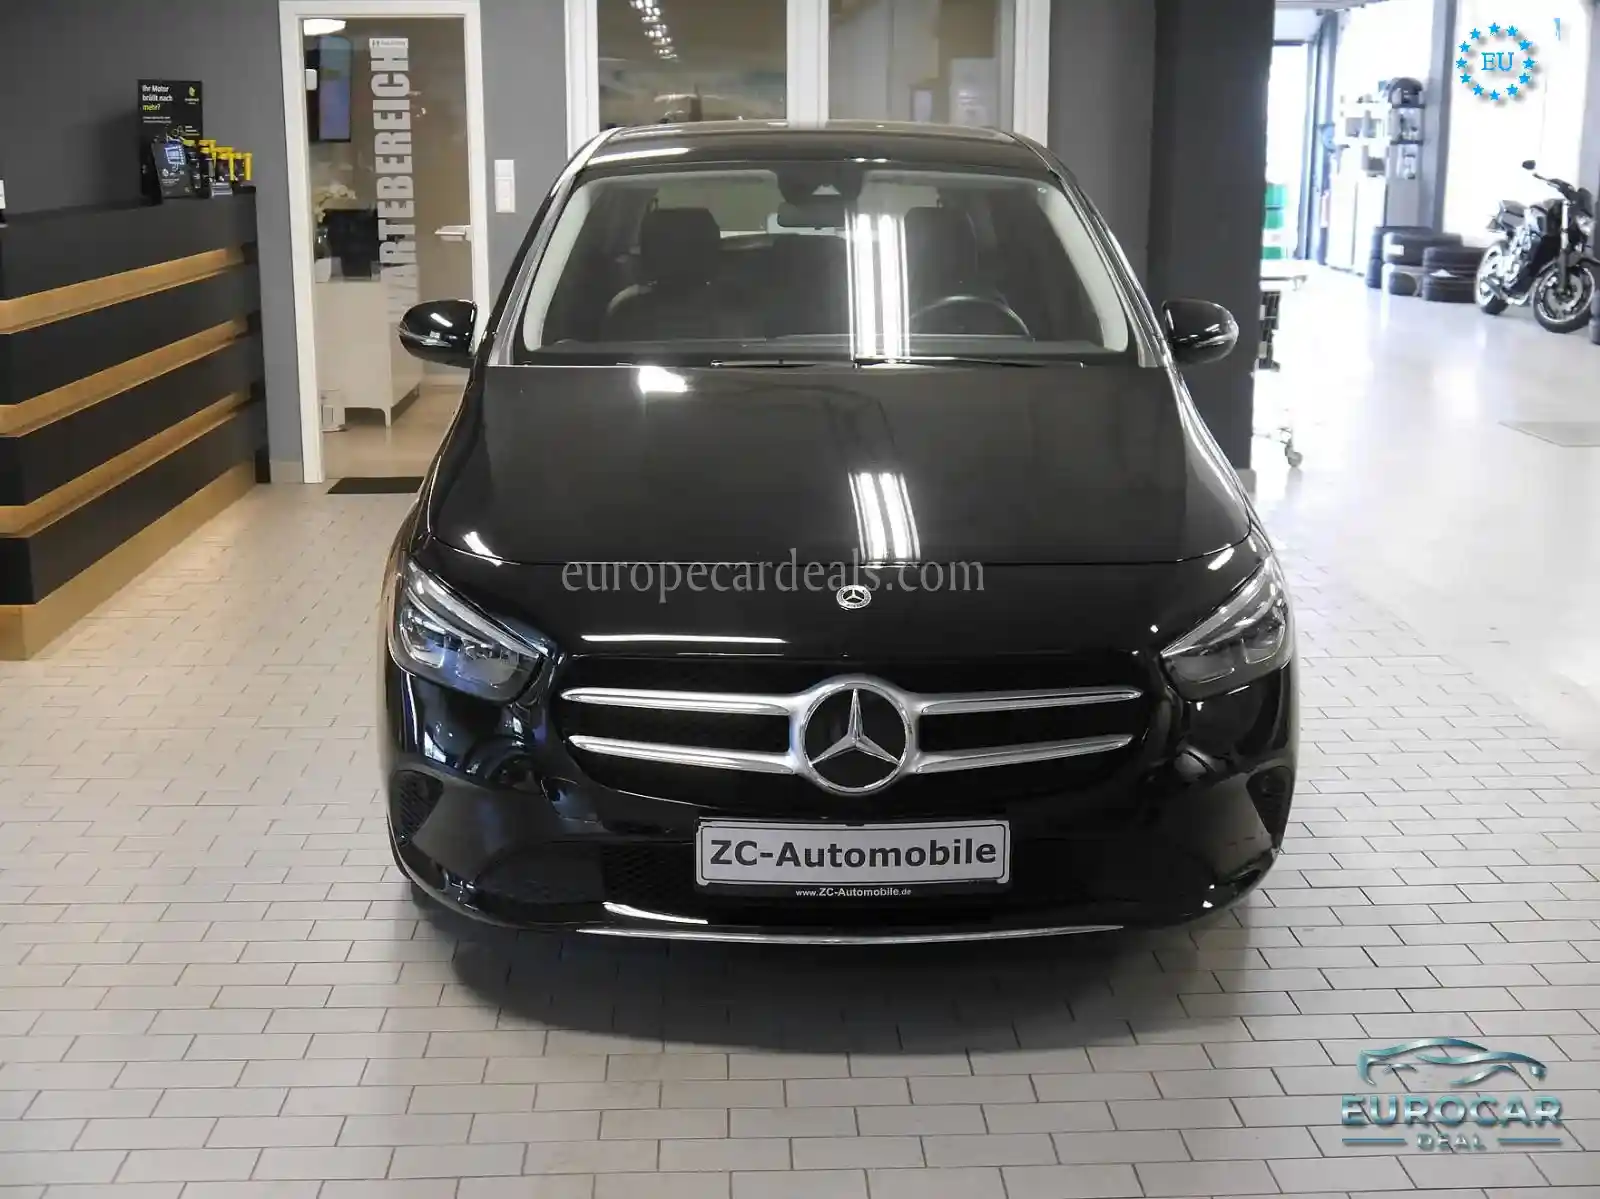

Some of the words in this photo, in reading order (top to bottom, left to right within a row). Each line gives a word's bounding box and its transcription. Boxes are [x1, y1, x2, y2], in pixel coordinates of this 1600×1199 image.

[142, 94, 159, 102] brüllt
[142, 103, 161, 111] mehr?
[709, 838, 997, 868] ZC-Automobile
[795, 887, 912, 898] www.ZC-Automobile.de
